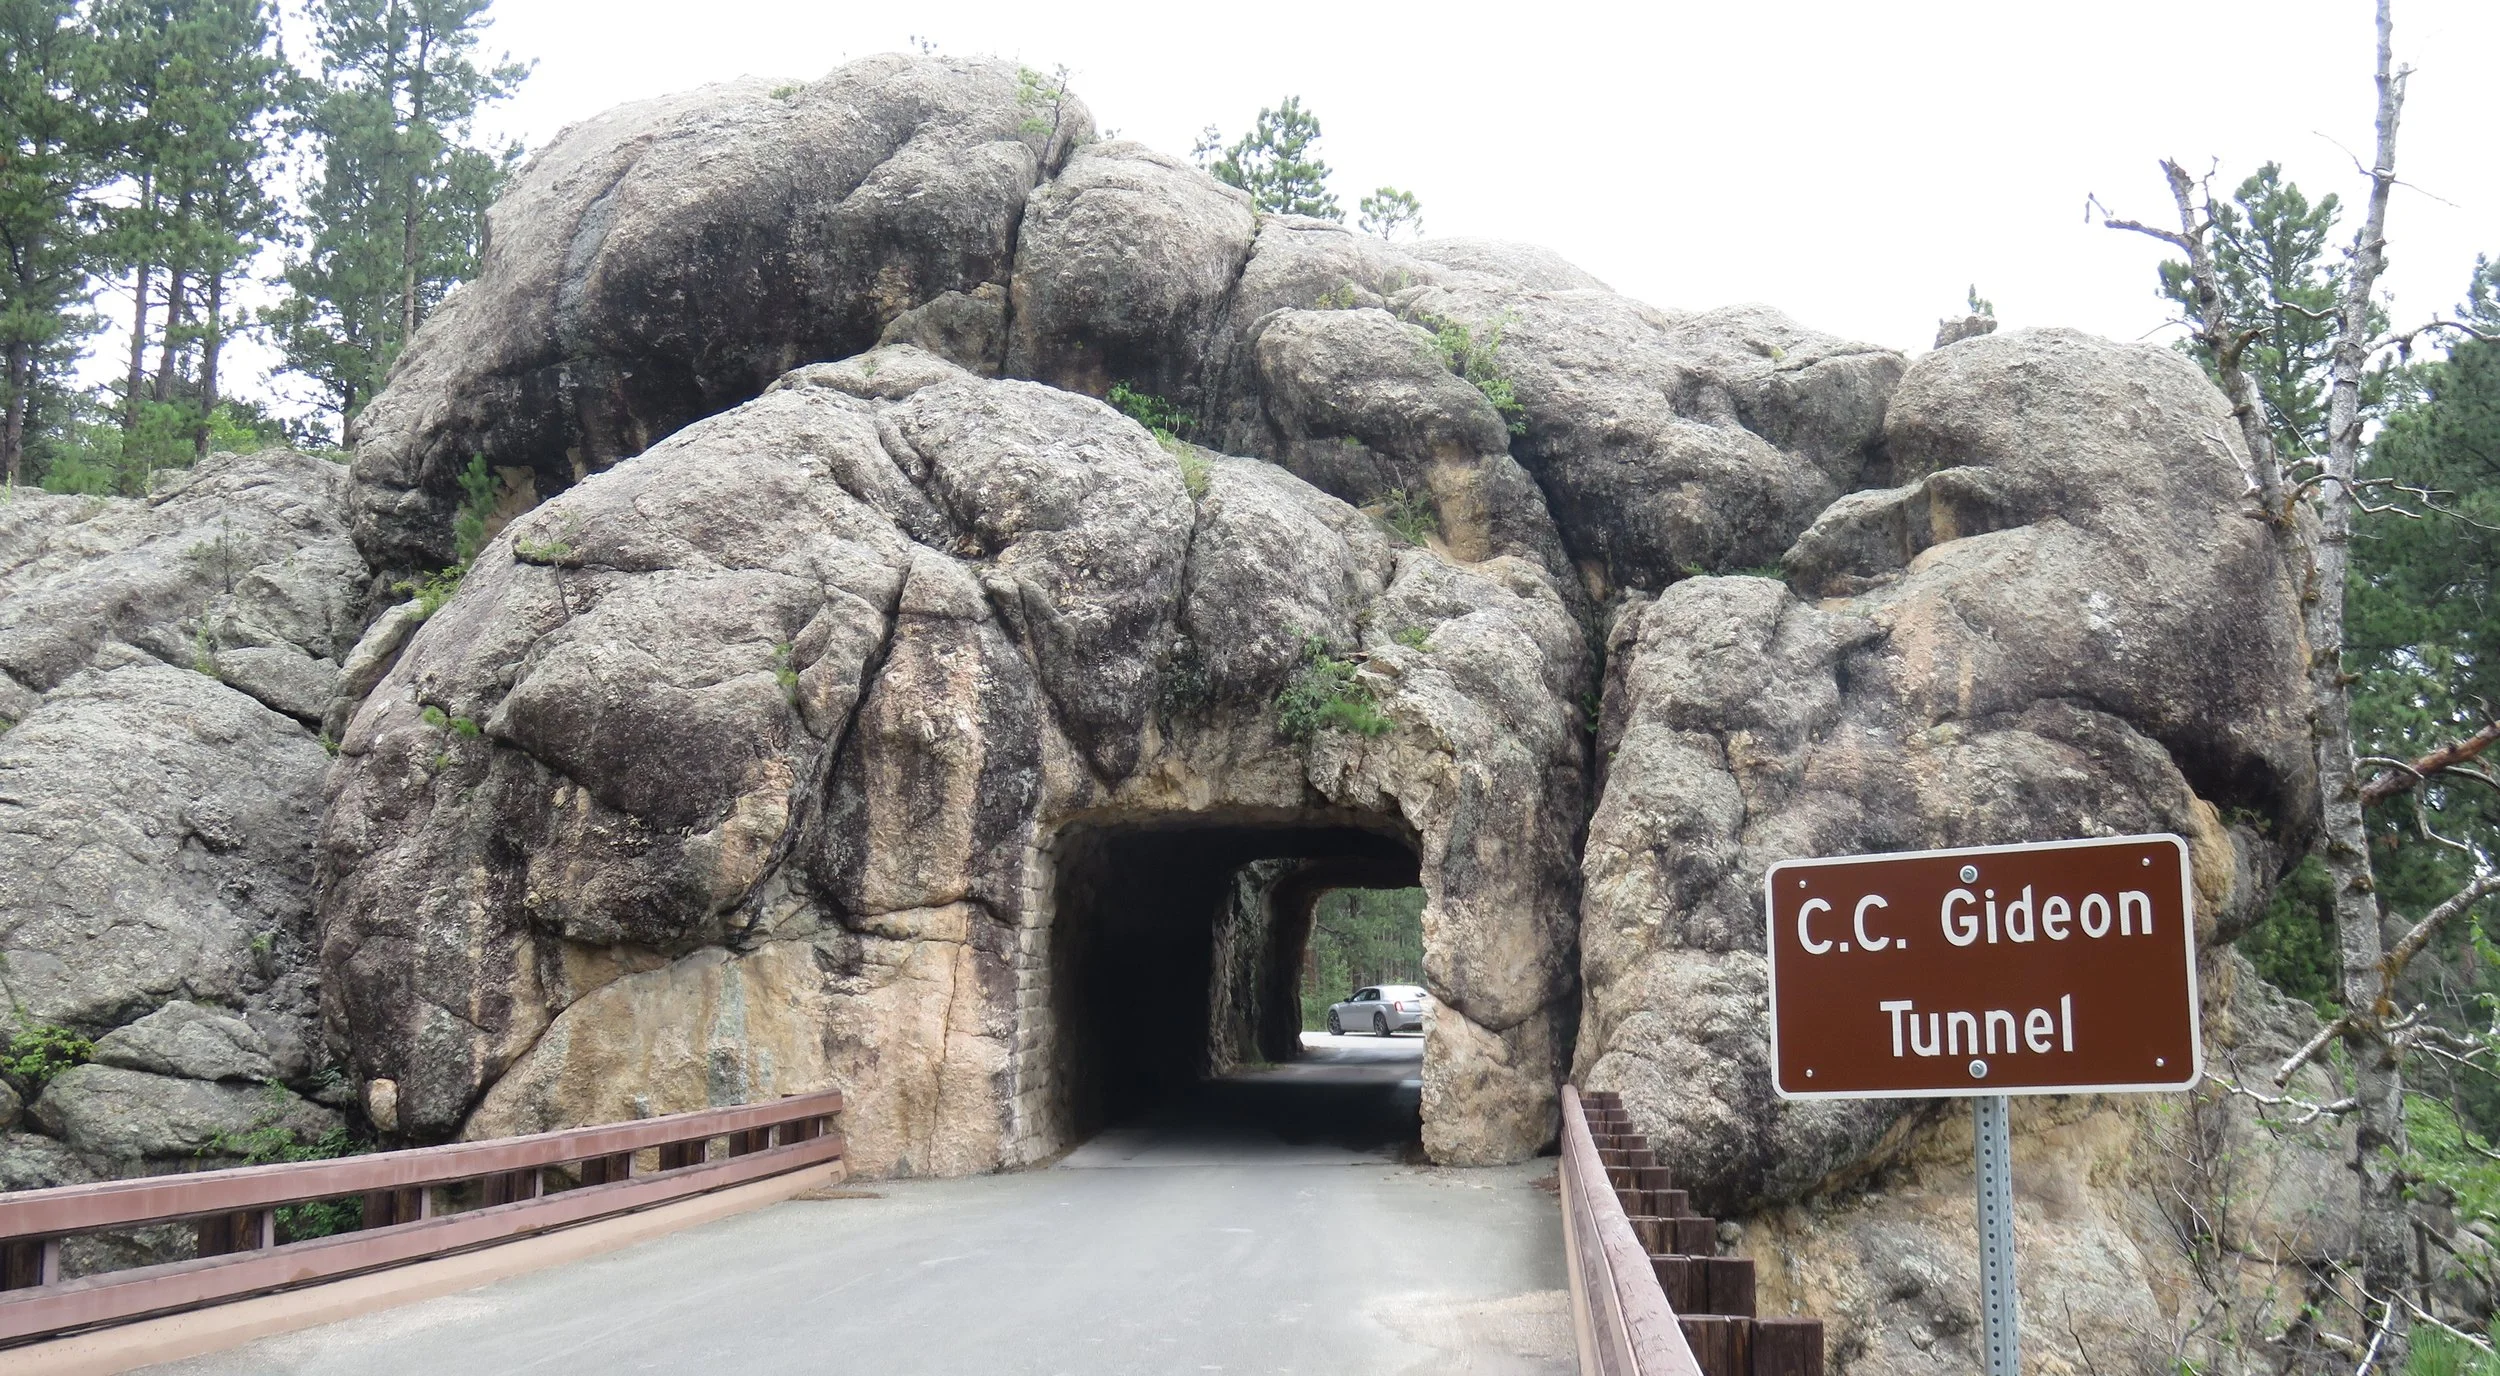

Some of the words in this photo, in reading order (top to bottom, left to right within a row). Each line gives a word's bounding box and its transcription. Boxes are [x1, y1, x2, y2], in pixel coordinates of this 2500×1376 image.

[1797, 894, 1907, 955] C.C.
[1941, 884, 2153, 947] Gideon
[1879, 993, 2073, 1057] Tunnel
